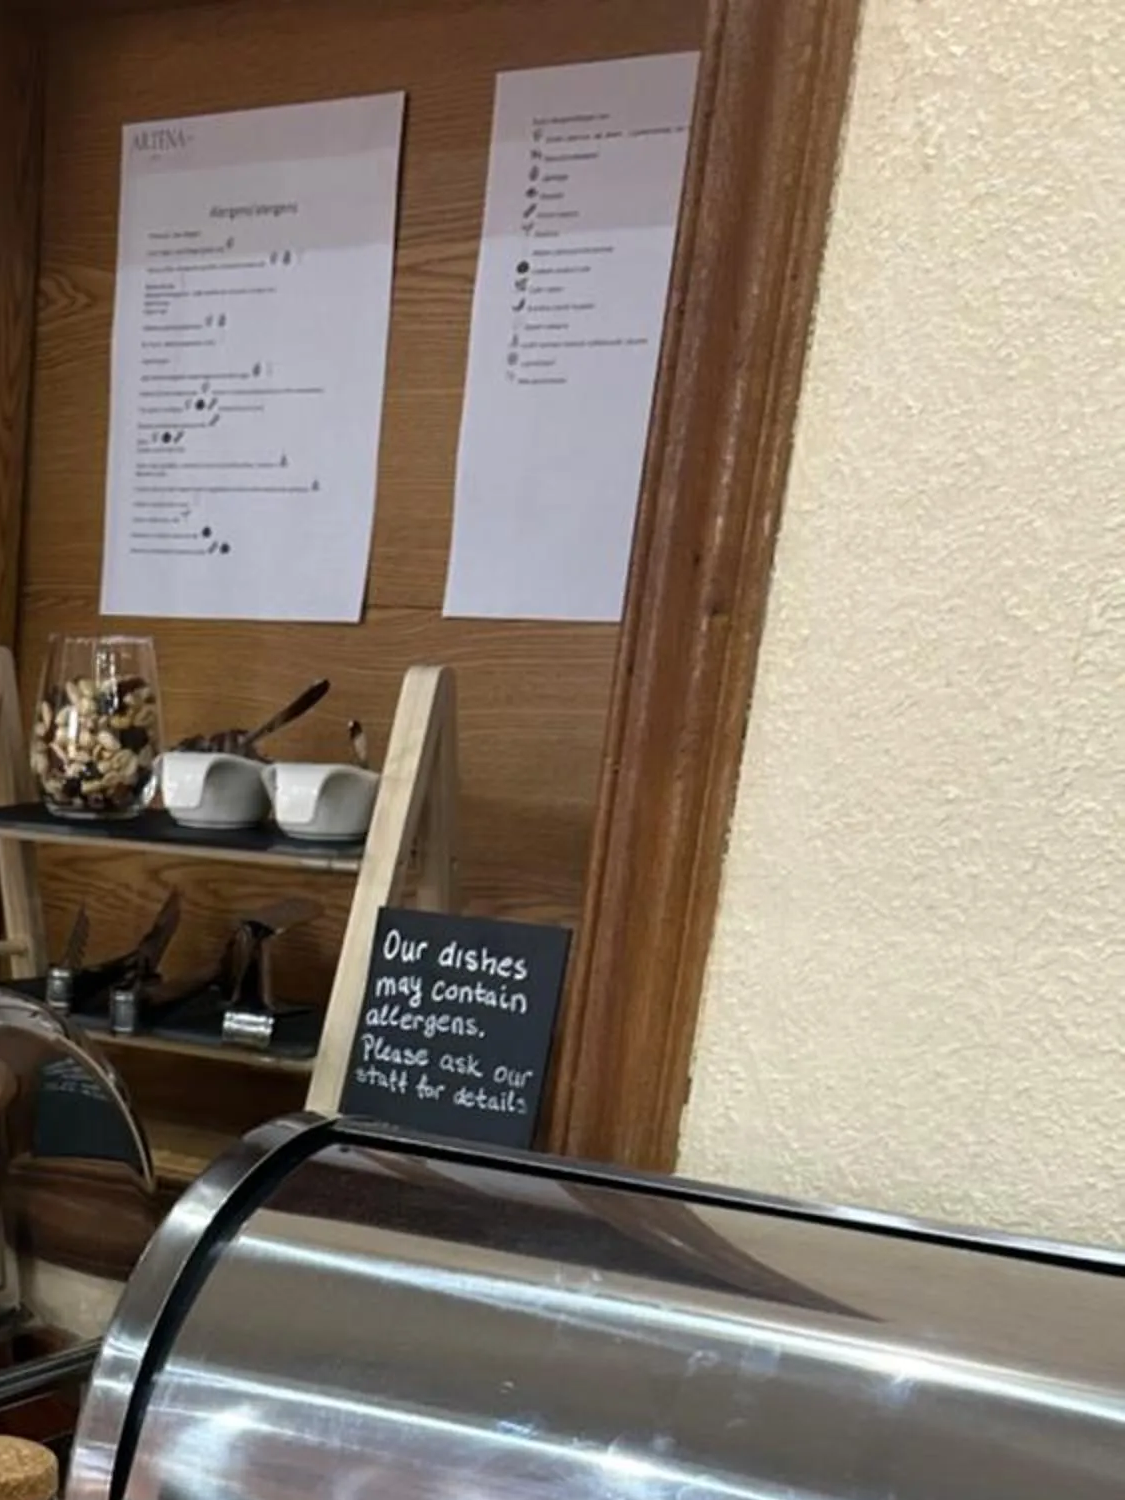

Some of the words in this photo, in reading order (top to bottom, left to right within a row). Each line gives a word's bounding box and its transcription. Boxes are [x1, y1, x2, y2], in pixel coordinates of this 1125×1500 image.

[383, 929, 427, 963] Our
[438, 941, 528, 980] dishes
[375, 975, 422, 1008] may
[365, 1004, 486, 1038] allergens.
[361, 1034, 429, 1066] Please
[440, 1053, 483, 1078] ask
[355, 1067, 408, 1094] staff
[416, 1073, 445, 1099] for
